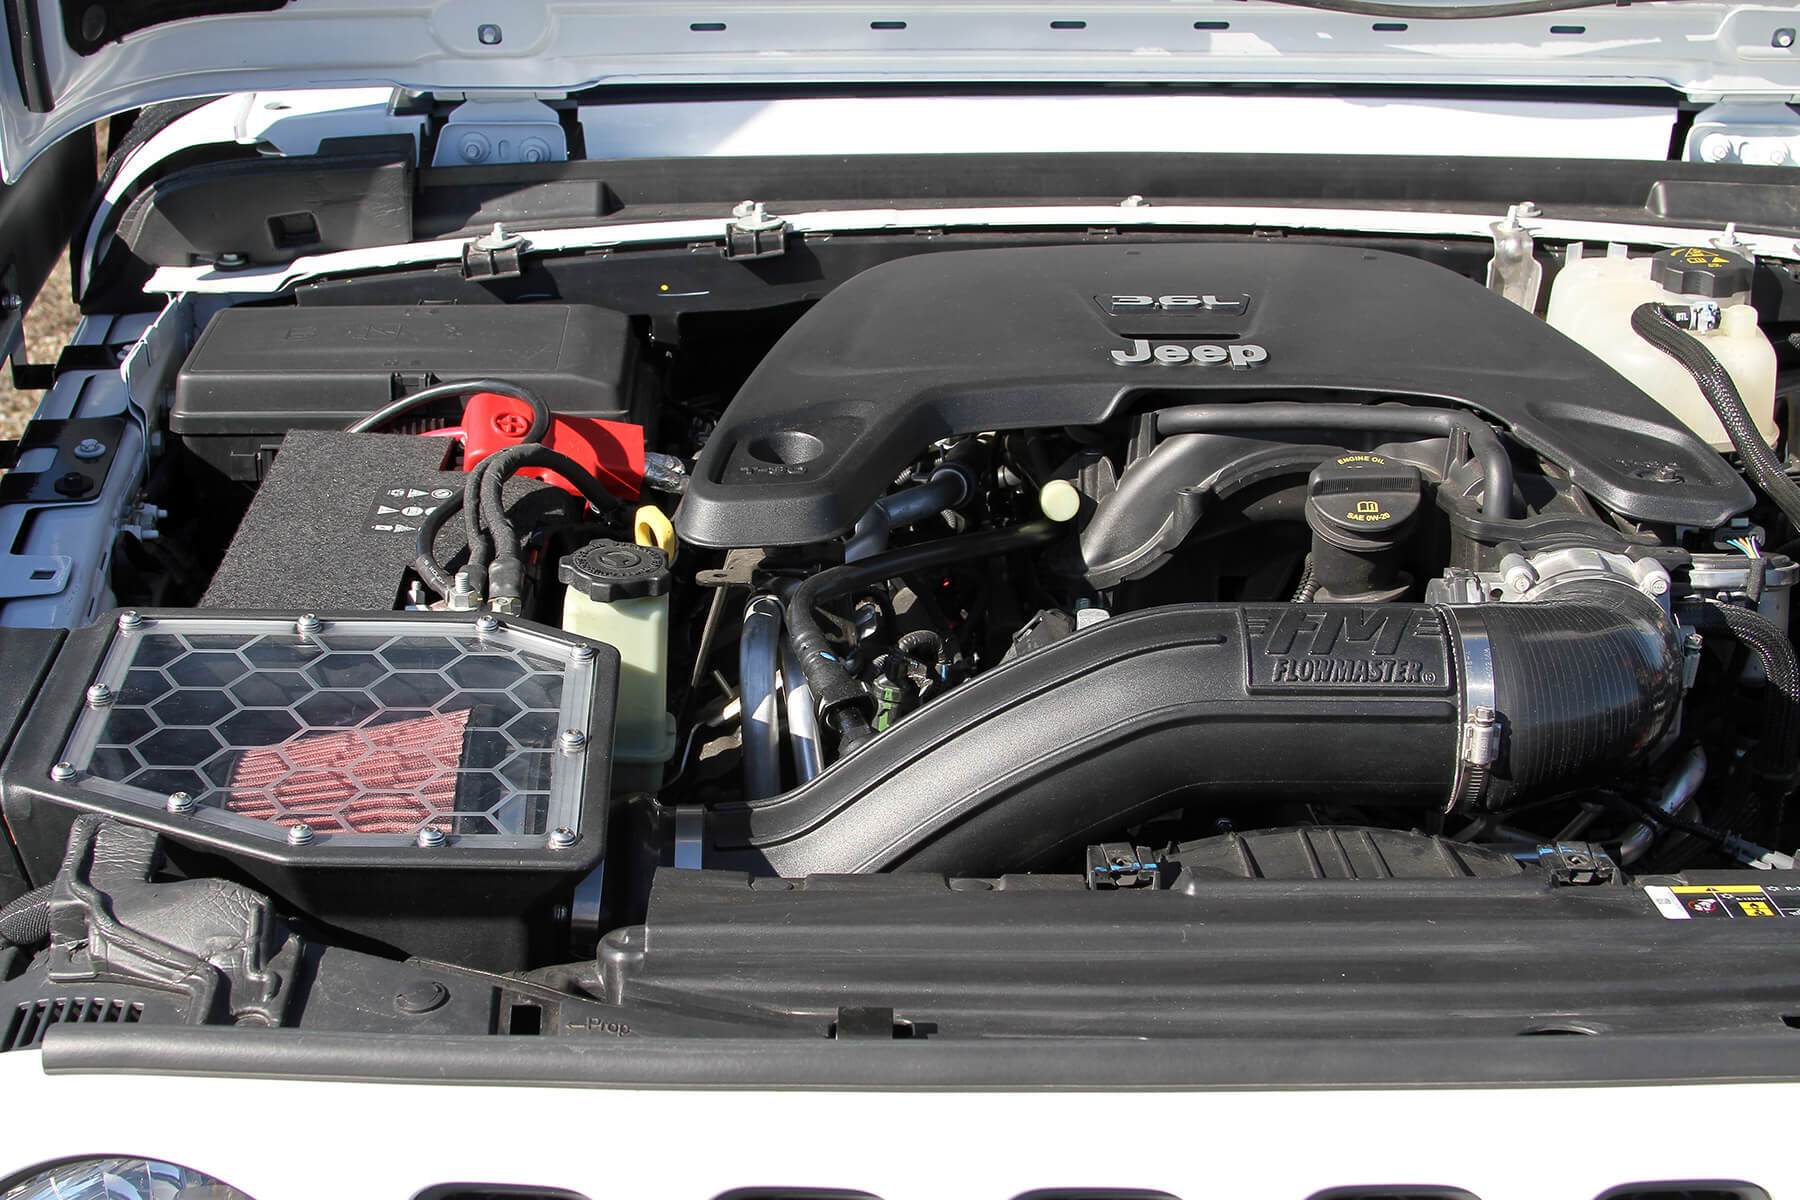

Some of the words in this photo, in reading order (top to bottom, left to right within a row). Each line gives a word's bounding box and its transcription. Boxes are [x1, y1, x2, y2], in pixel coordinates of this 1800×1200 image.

[1112, 295, 1240, 309] 3.6L
[1111, 339, 1270, 370] Jeep
[1337, 455, 1370, 465] ENGINE
[1371, 456, 1385, 465] OIL
[1347, 512, 1365, 521] SAE
[1265, 608, 1414, 656] FM
[586, 1016, 630, 1037] Prop
